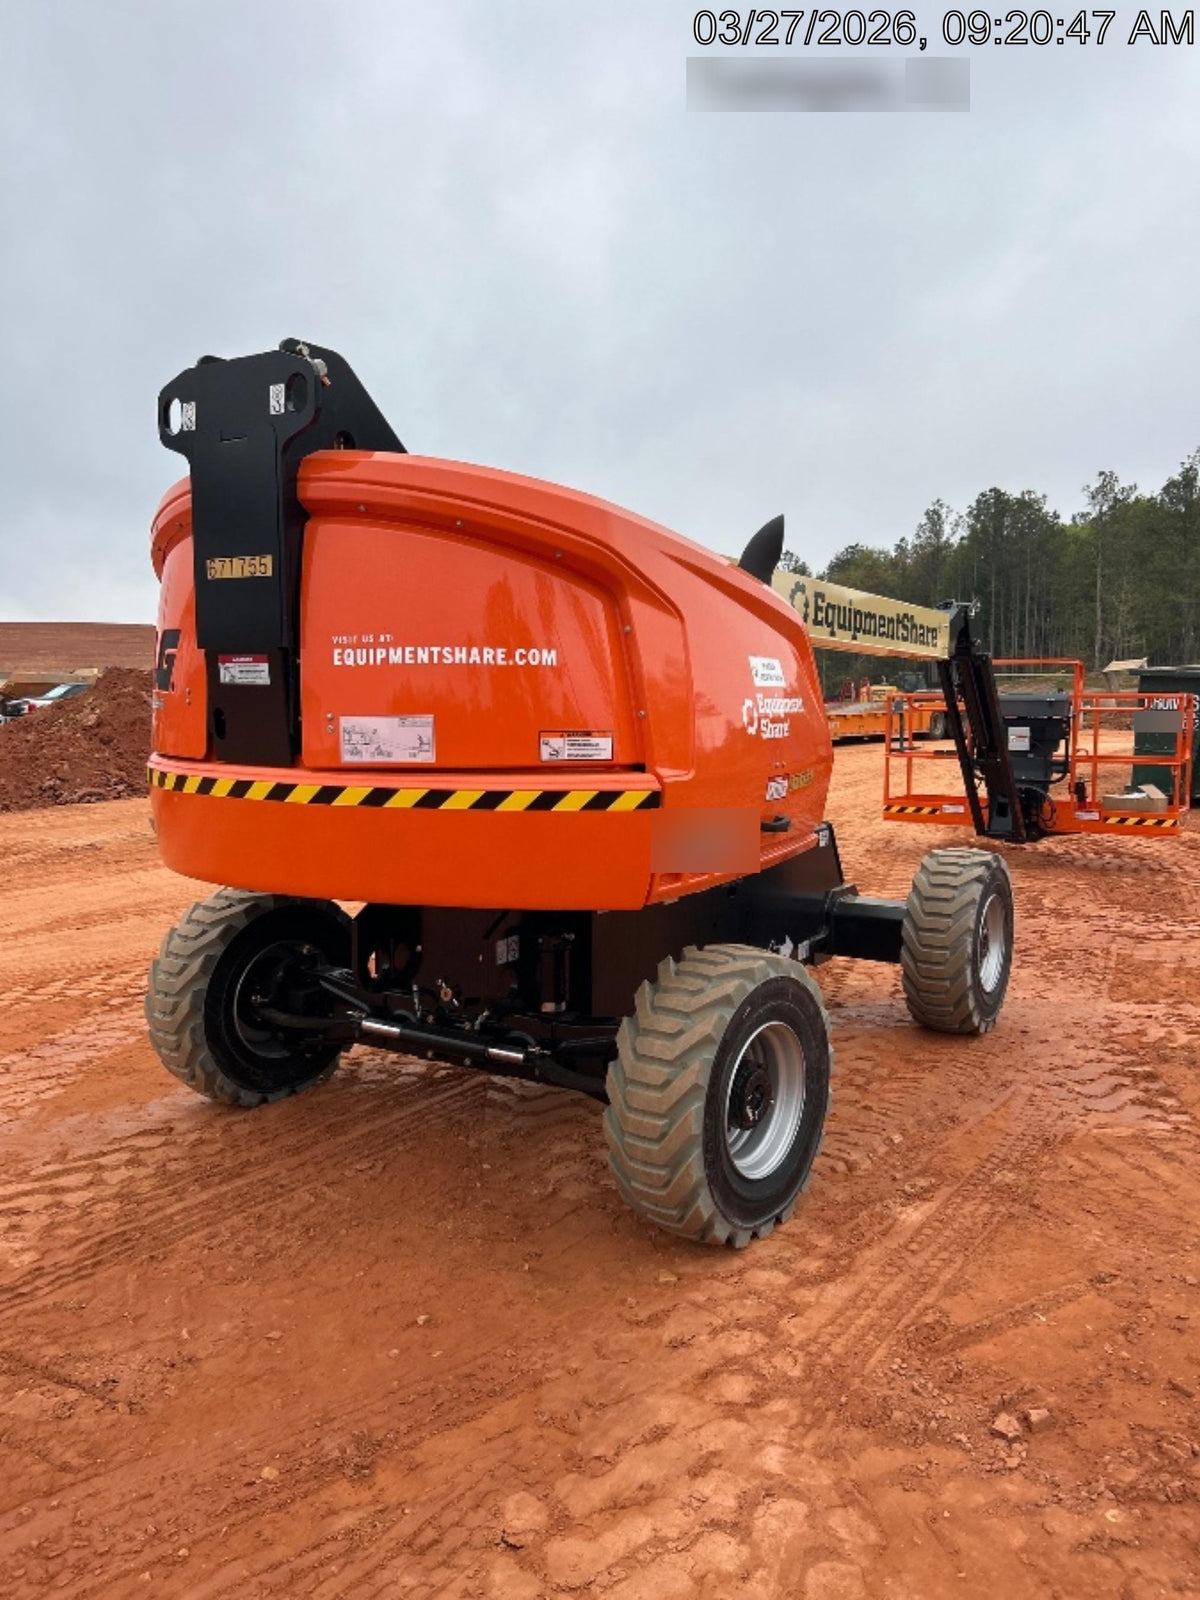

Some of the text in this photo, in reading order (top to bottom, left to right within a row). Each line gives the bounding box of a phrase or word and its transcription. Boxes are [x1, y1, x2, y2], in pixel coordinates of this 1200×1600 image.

[208, 556, 268, 579] 671755
[812, 591, 938, 648] EquipmentShare
[362, 634, 375, 643] US
[333, 646, 558, 667] EQUIPMENTSHARE.COM
